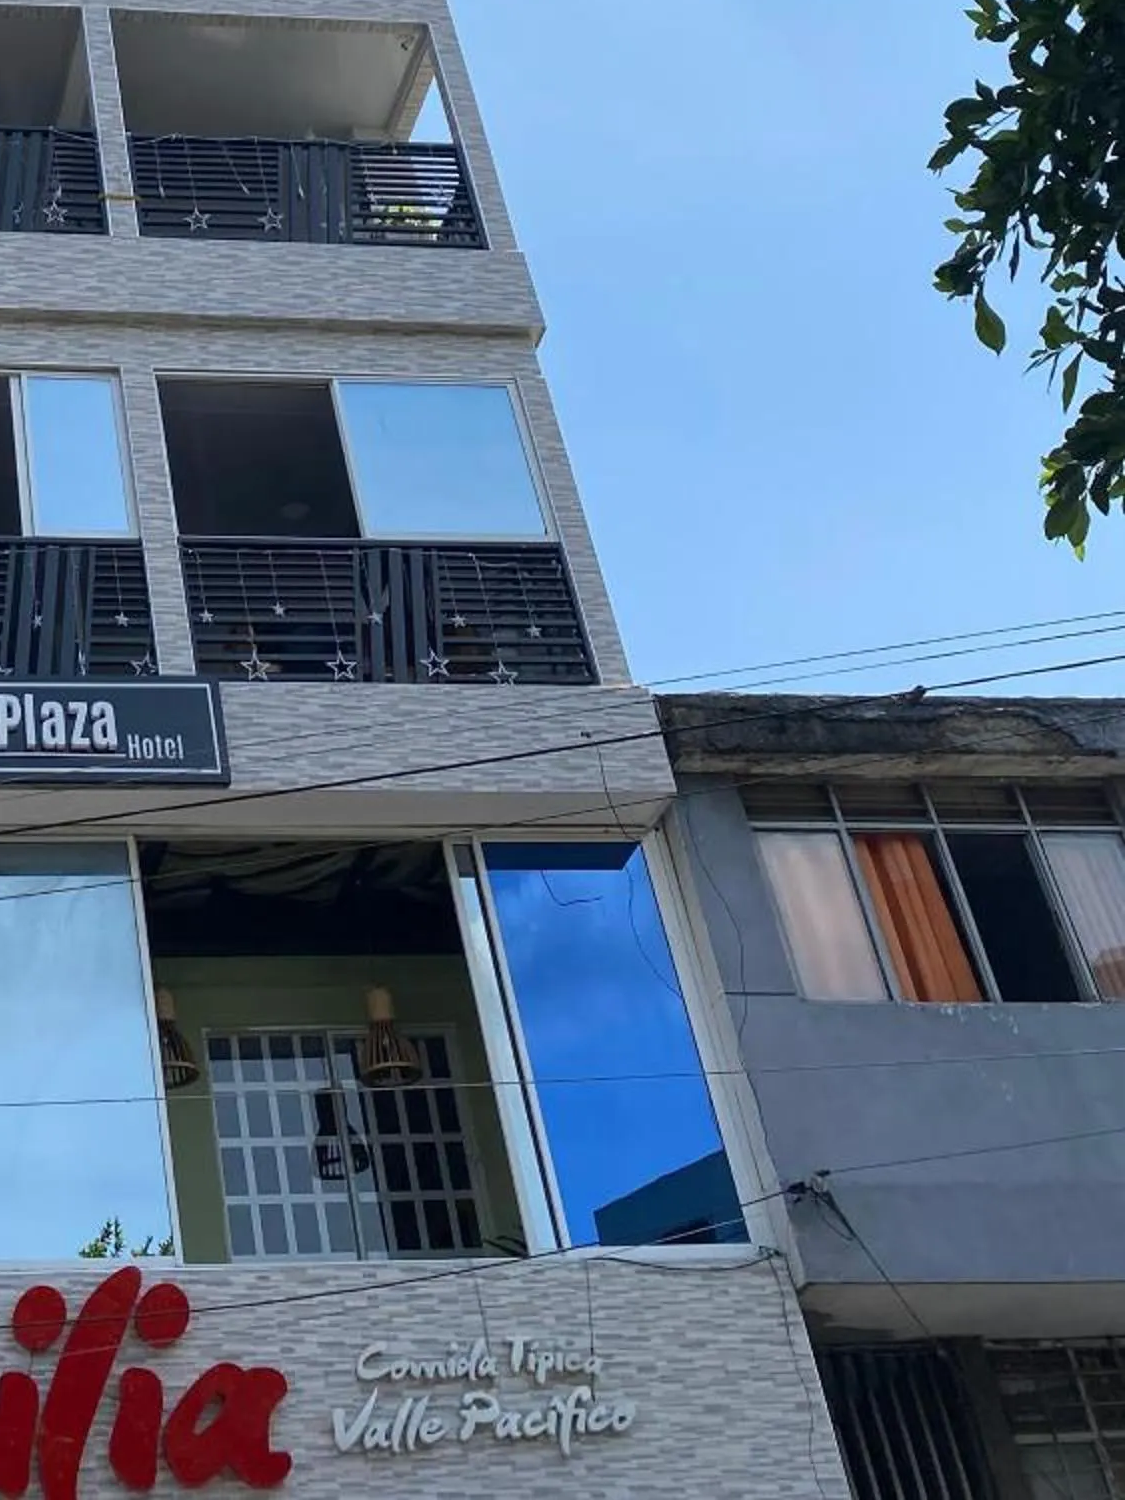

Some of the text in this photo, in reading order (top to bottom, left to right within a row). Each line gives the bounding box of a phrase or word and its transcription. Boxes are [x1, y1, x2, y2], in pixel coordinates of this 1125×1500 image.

[126, 732, 184, 761] Hotel
[357, 1342, 499, 1382] Comida
[331, 1387, 446, 1453] Valle
